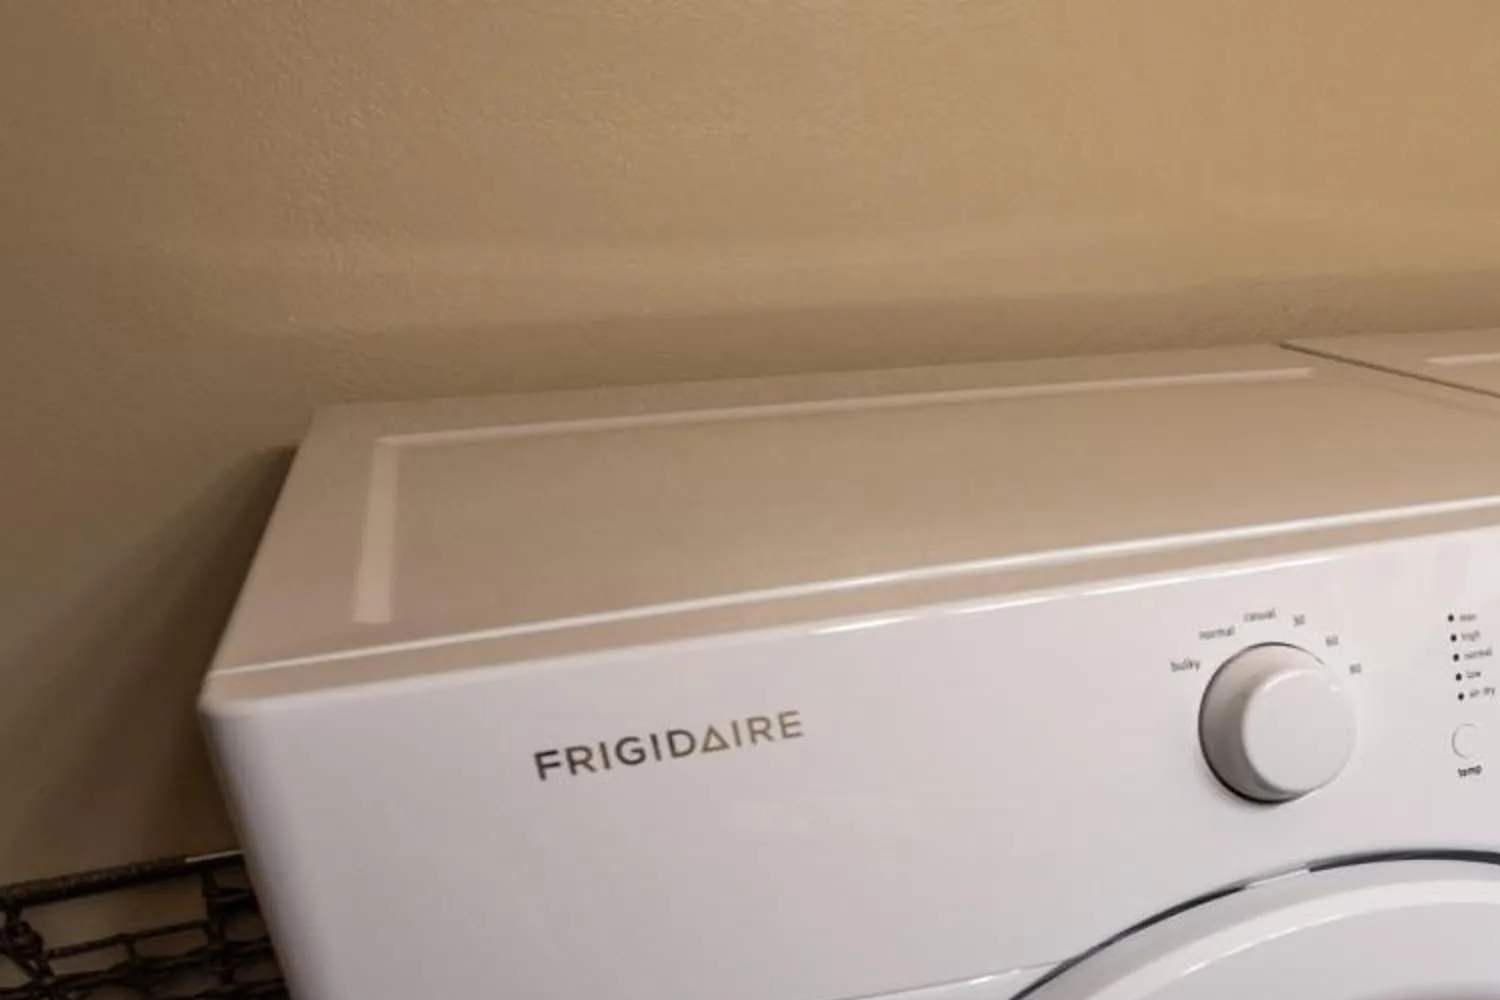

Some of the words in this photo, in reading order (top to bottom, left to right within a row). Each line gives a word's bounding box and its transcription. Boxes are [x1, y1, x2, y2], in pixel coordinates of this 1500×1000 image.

[1198, 626, 1235, 640] normal
[1170, 657, 1201, 673] bulky
[533, 710, 804, 782] FRIGIDAIRE
